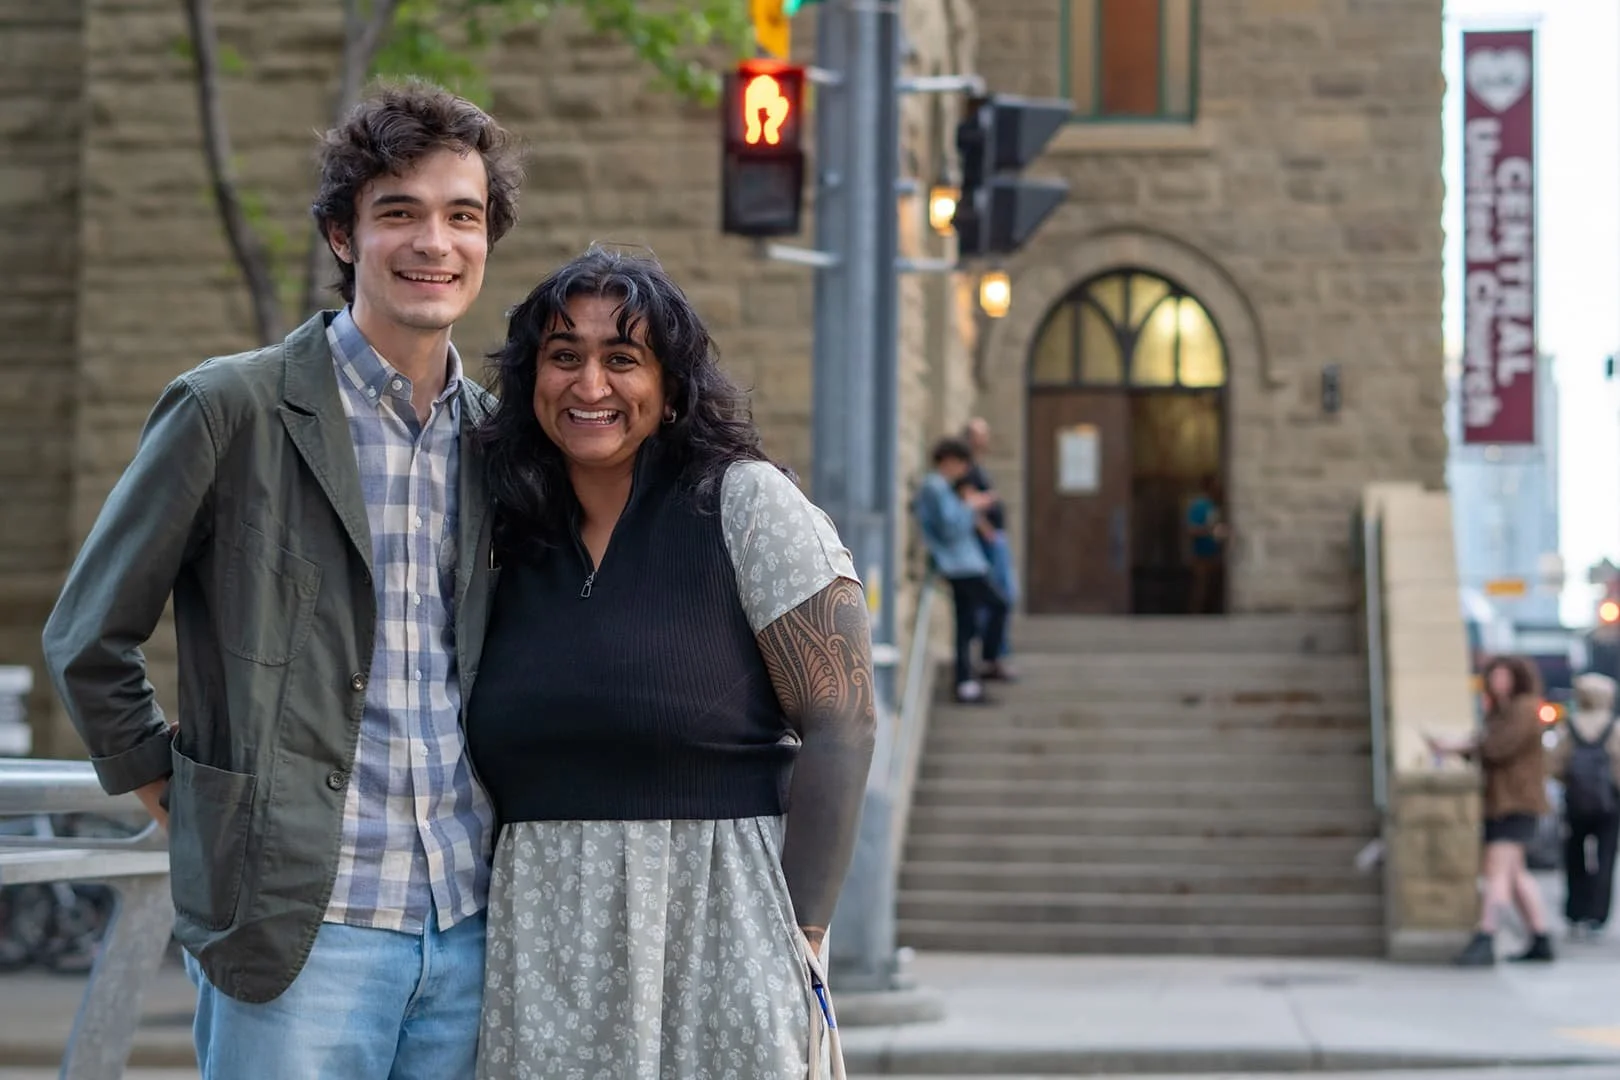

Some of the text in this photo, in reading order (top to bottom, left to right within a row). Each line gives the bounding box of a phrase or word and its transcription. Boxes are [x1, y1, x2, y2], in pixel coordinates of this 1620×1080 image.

[1465, 118, 1501, 427] United Church
[1498, 157, 1533, 386] CENTRAL
